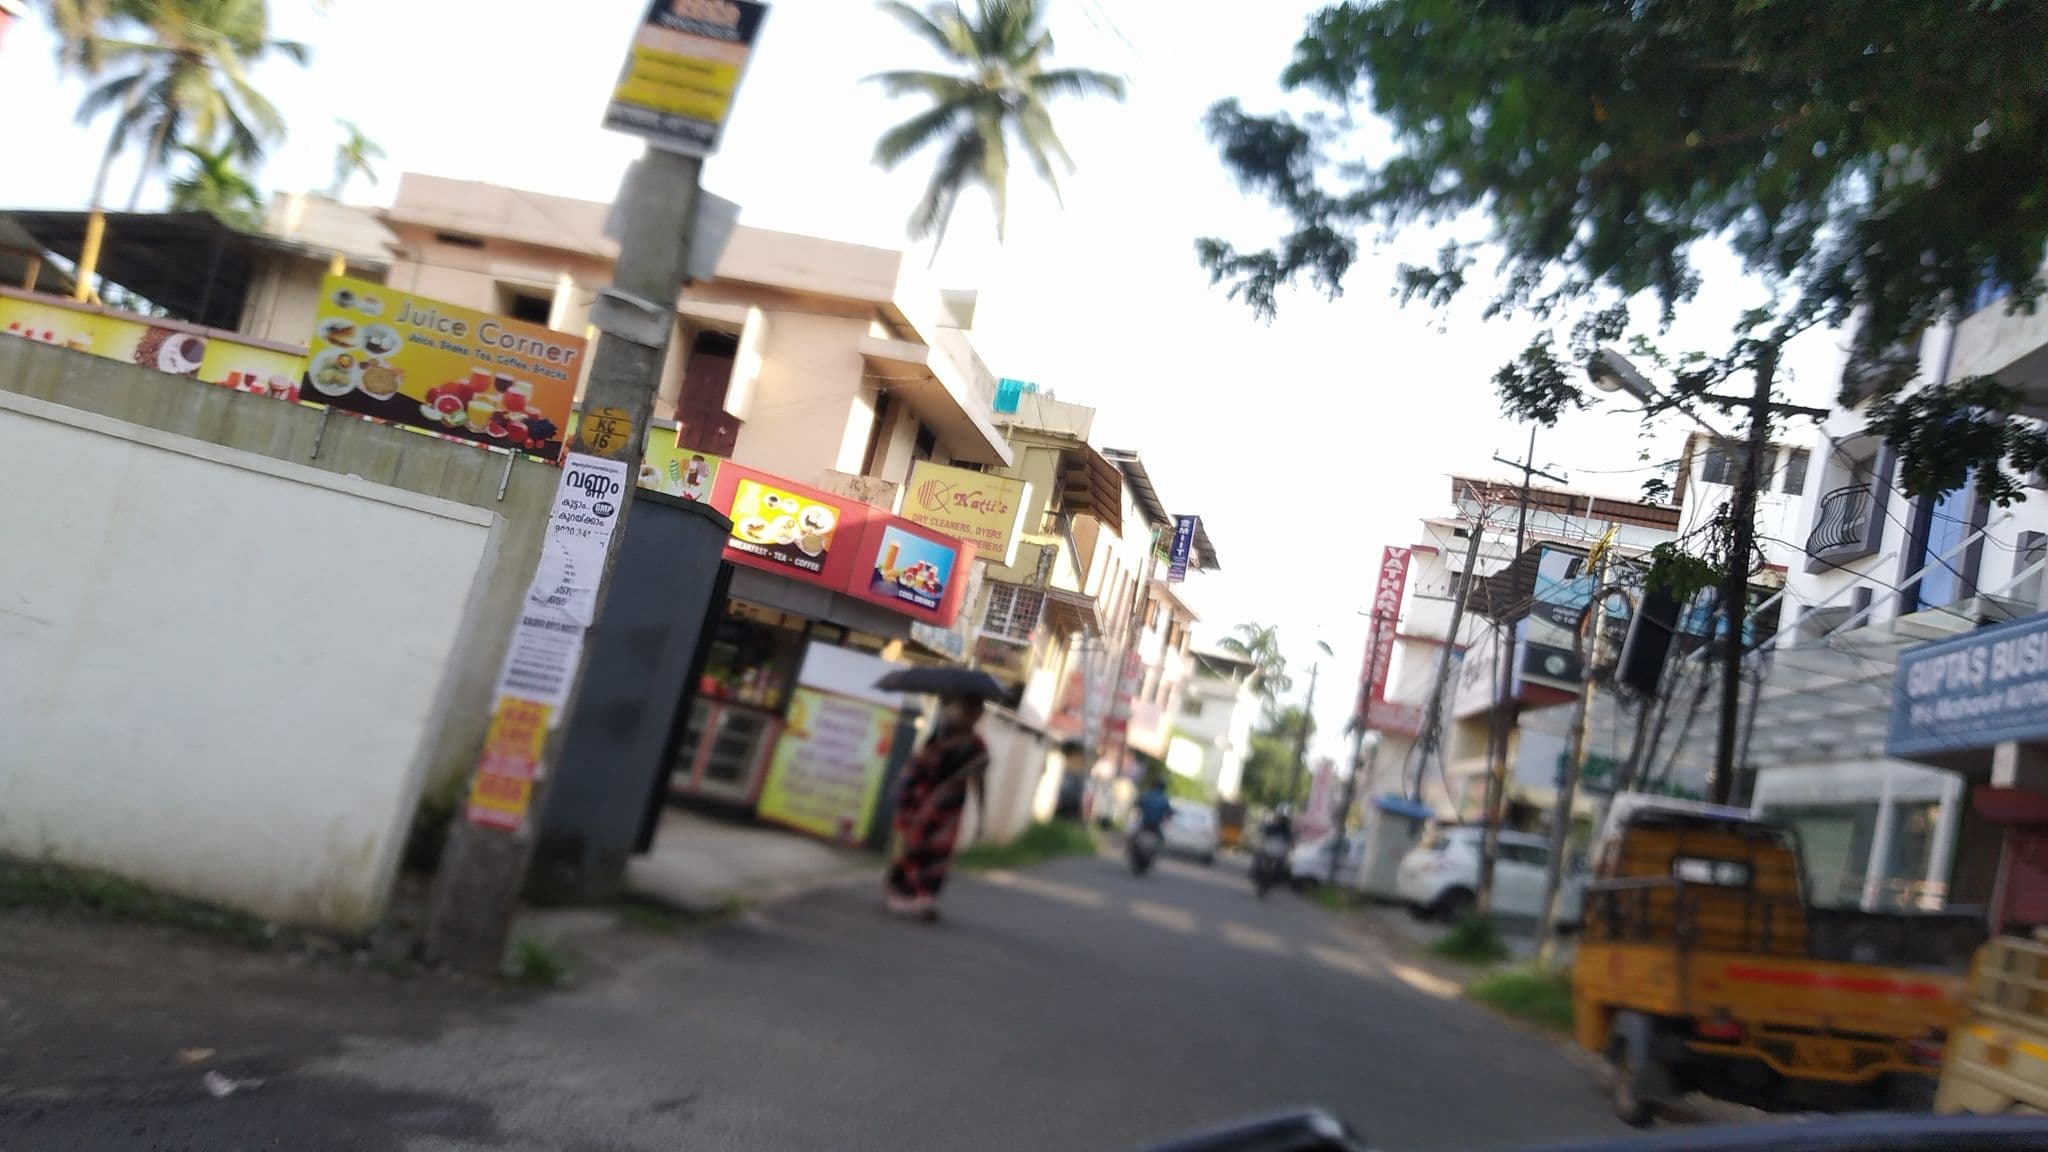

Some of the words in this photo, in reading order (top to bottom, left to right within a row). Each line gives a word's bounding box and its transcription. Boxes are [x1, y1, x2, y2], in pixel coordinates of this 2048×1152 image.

[394, 302, 468, 338] Juice
[478, 319, 576, 365] Corner
[566, 470, 619, 499] വണ്ണം
[912, 513, 928, 525] DRY
[975, 527, 1002, 540] DYERS
[728, 538, 768, 556] BREAKFAST
[774, 551, 787, 562] TEA
[794, 558, 820, 571] COFFEE
[898, 590, 914, 601] COOL
